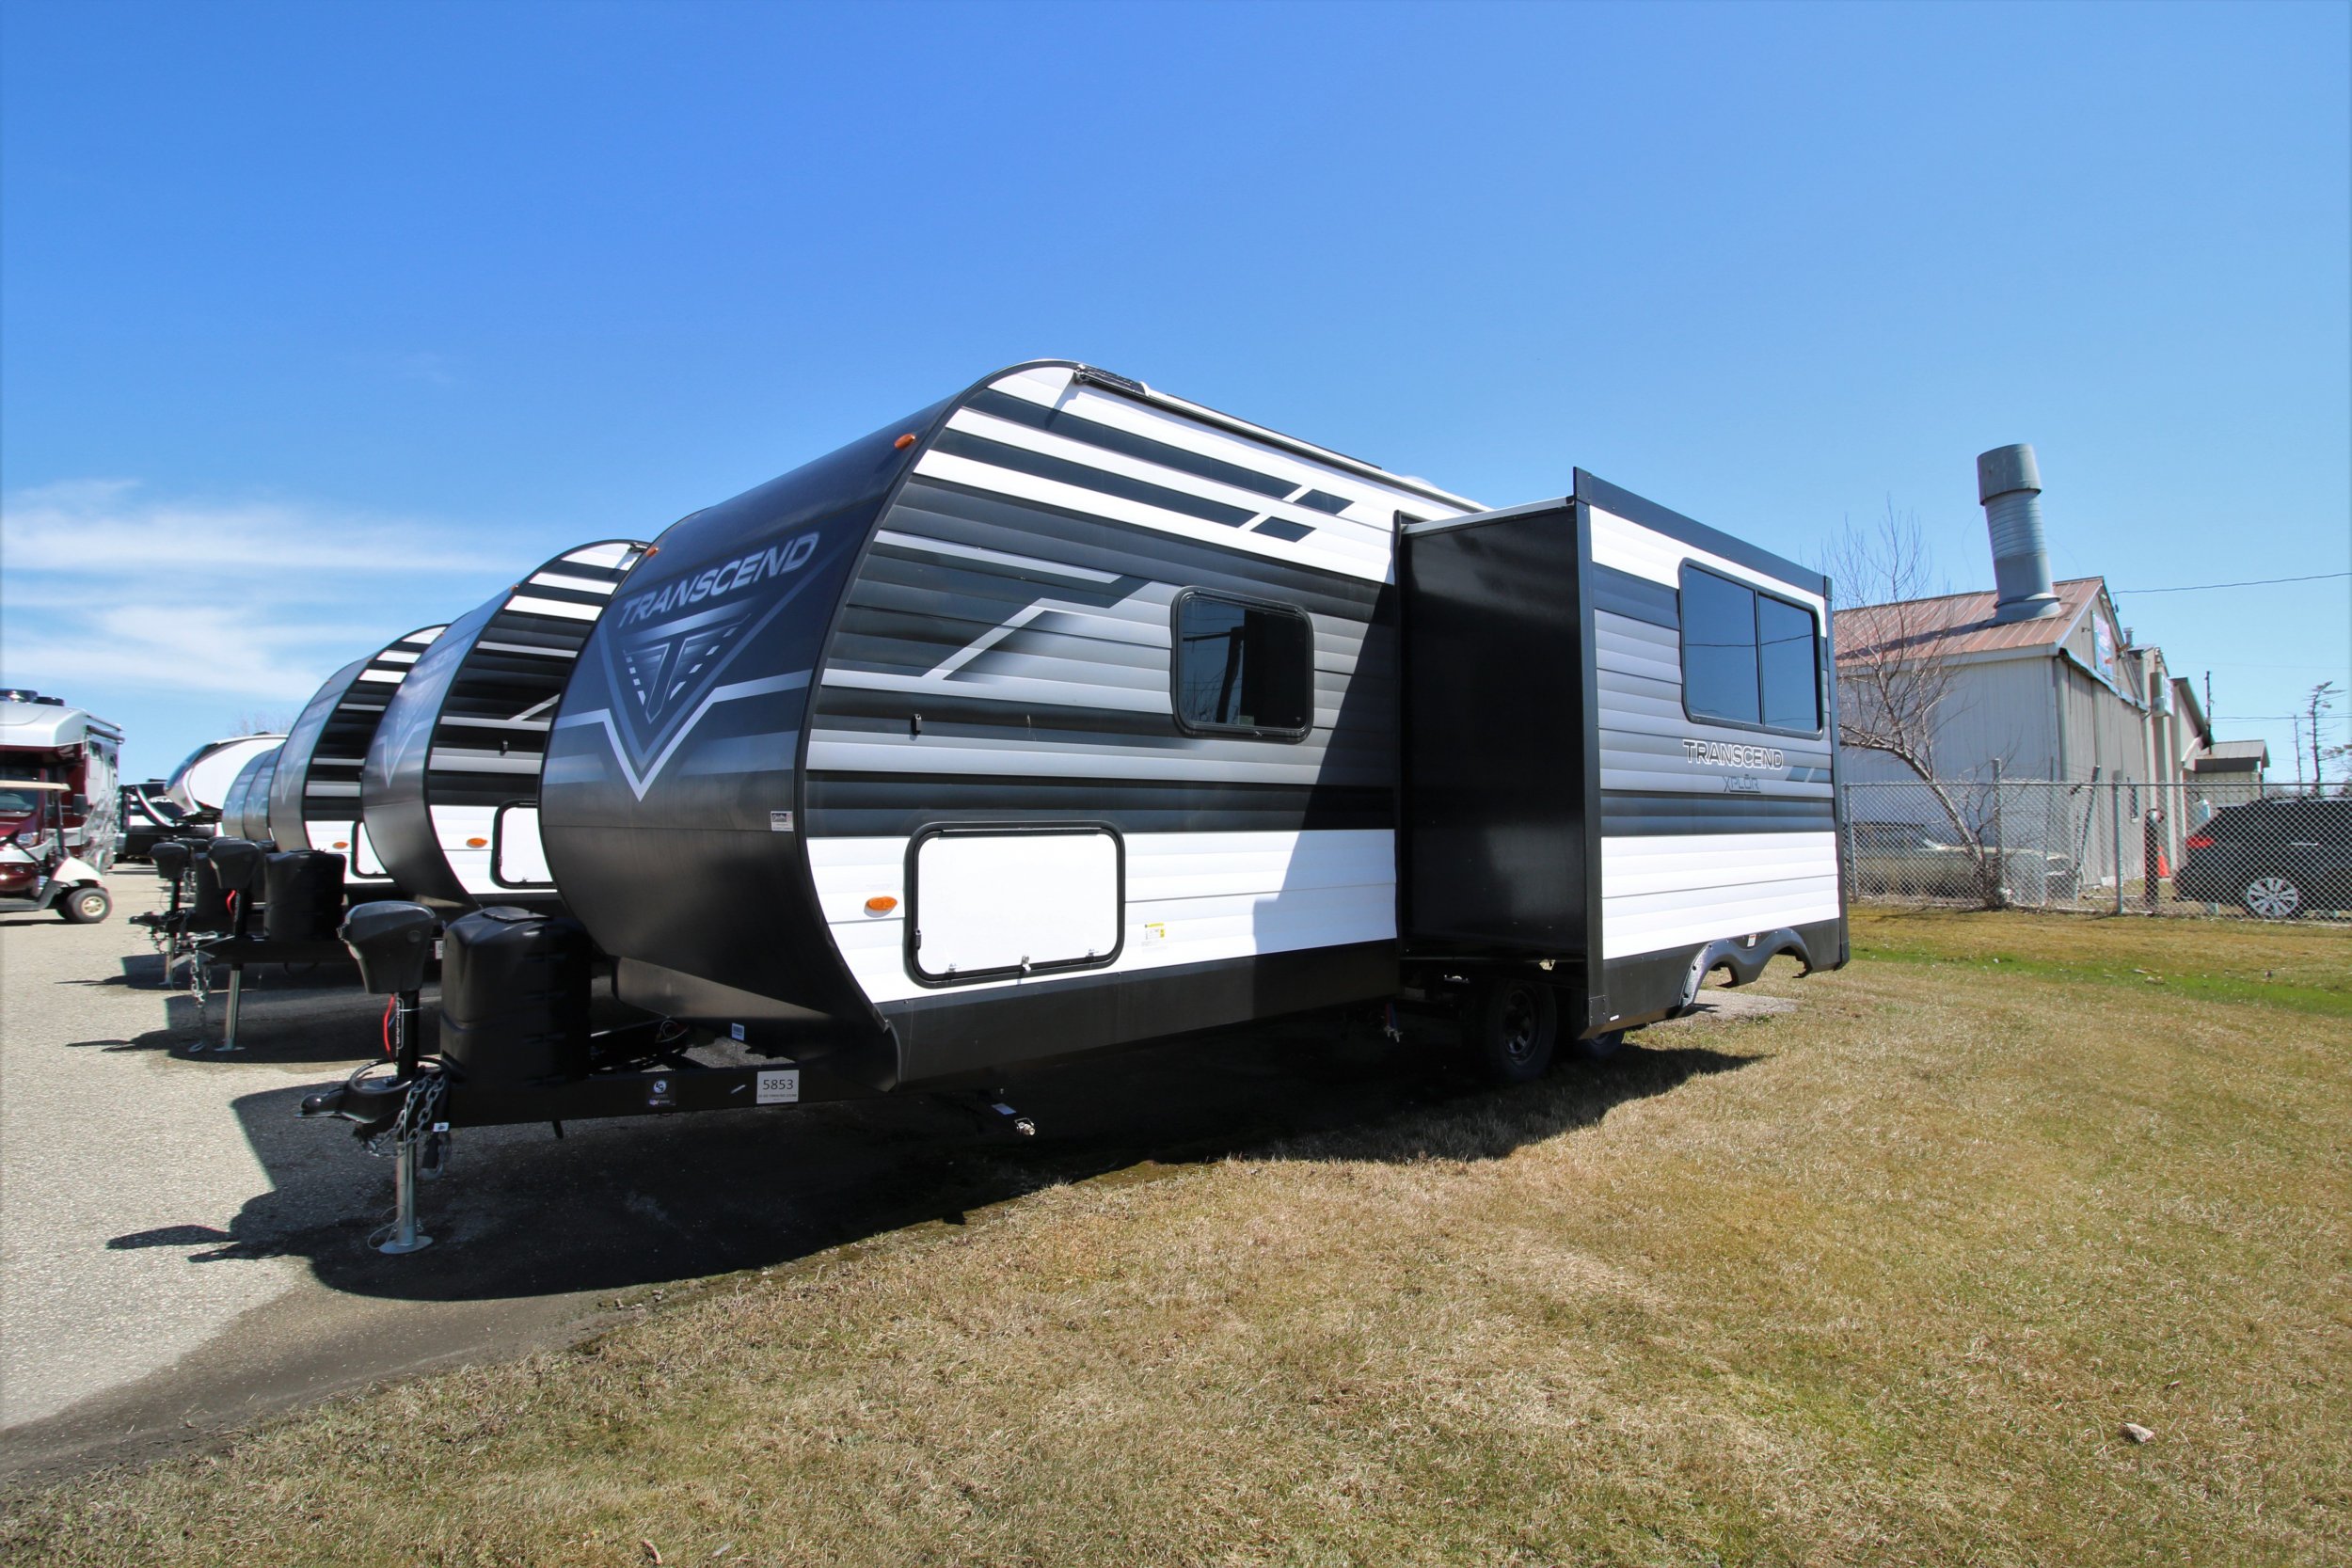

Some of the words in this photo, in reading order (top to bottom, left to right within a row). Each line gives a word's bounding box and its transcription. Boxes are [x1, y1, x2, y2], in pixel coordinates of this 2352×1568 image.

[618, 531, 820, 629] TRANSCEND
[1682, 739, 1784, 770] TRANSCEND
[762, 1079, 794, 1090] 5853
